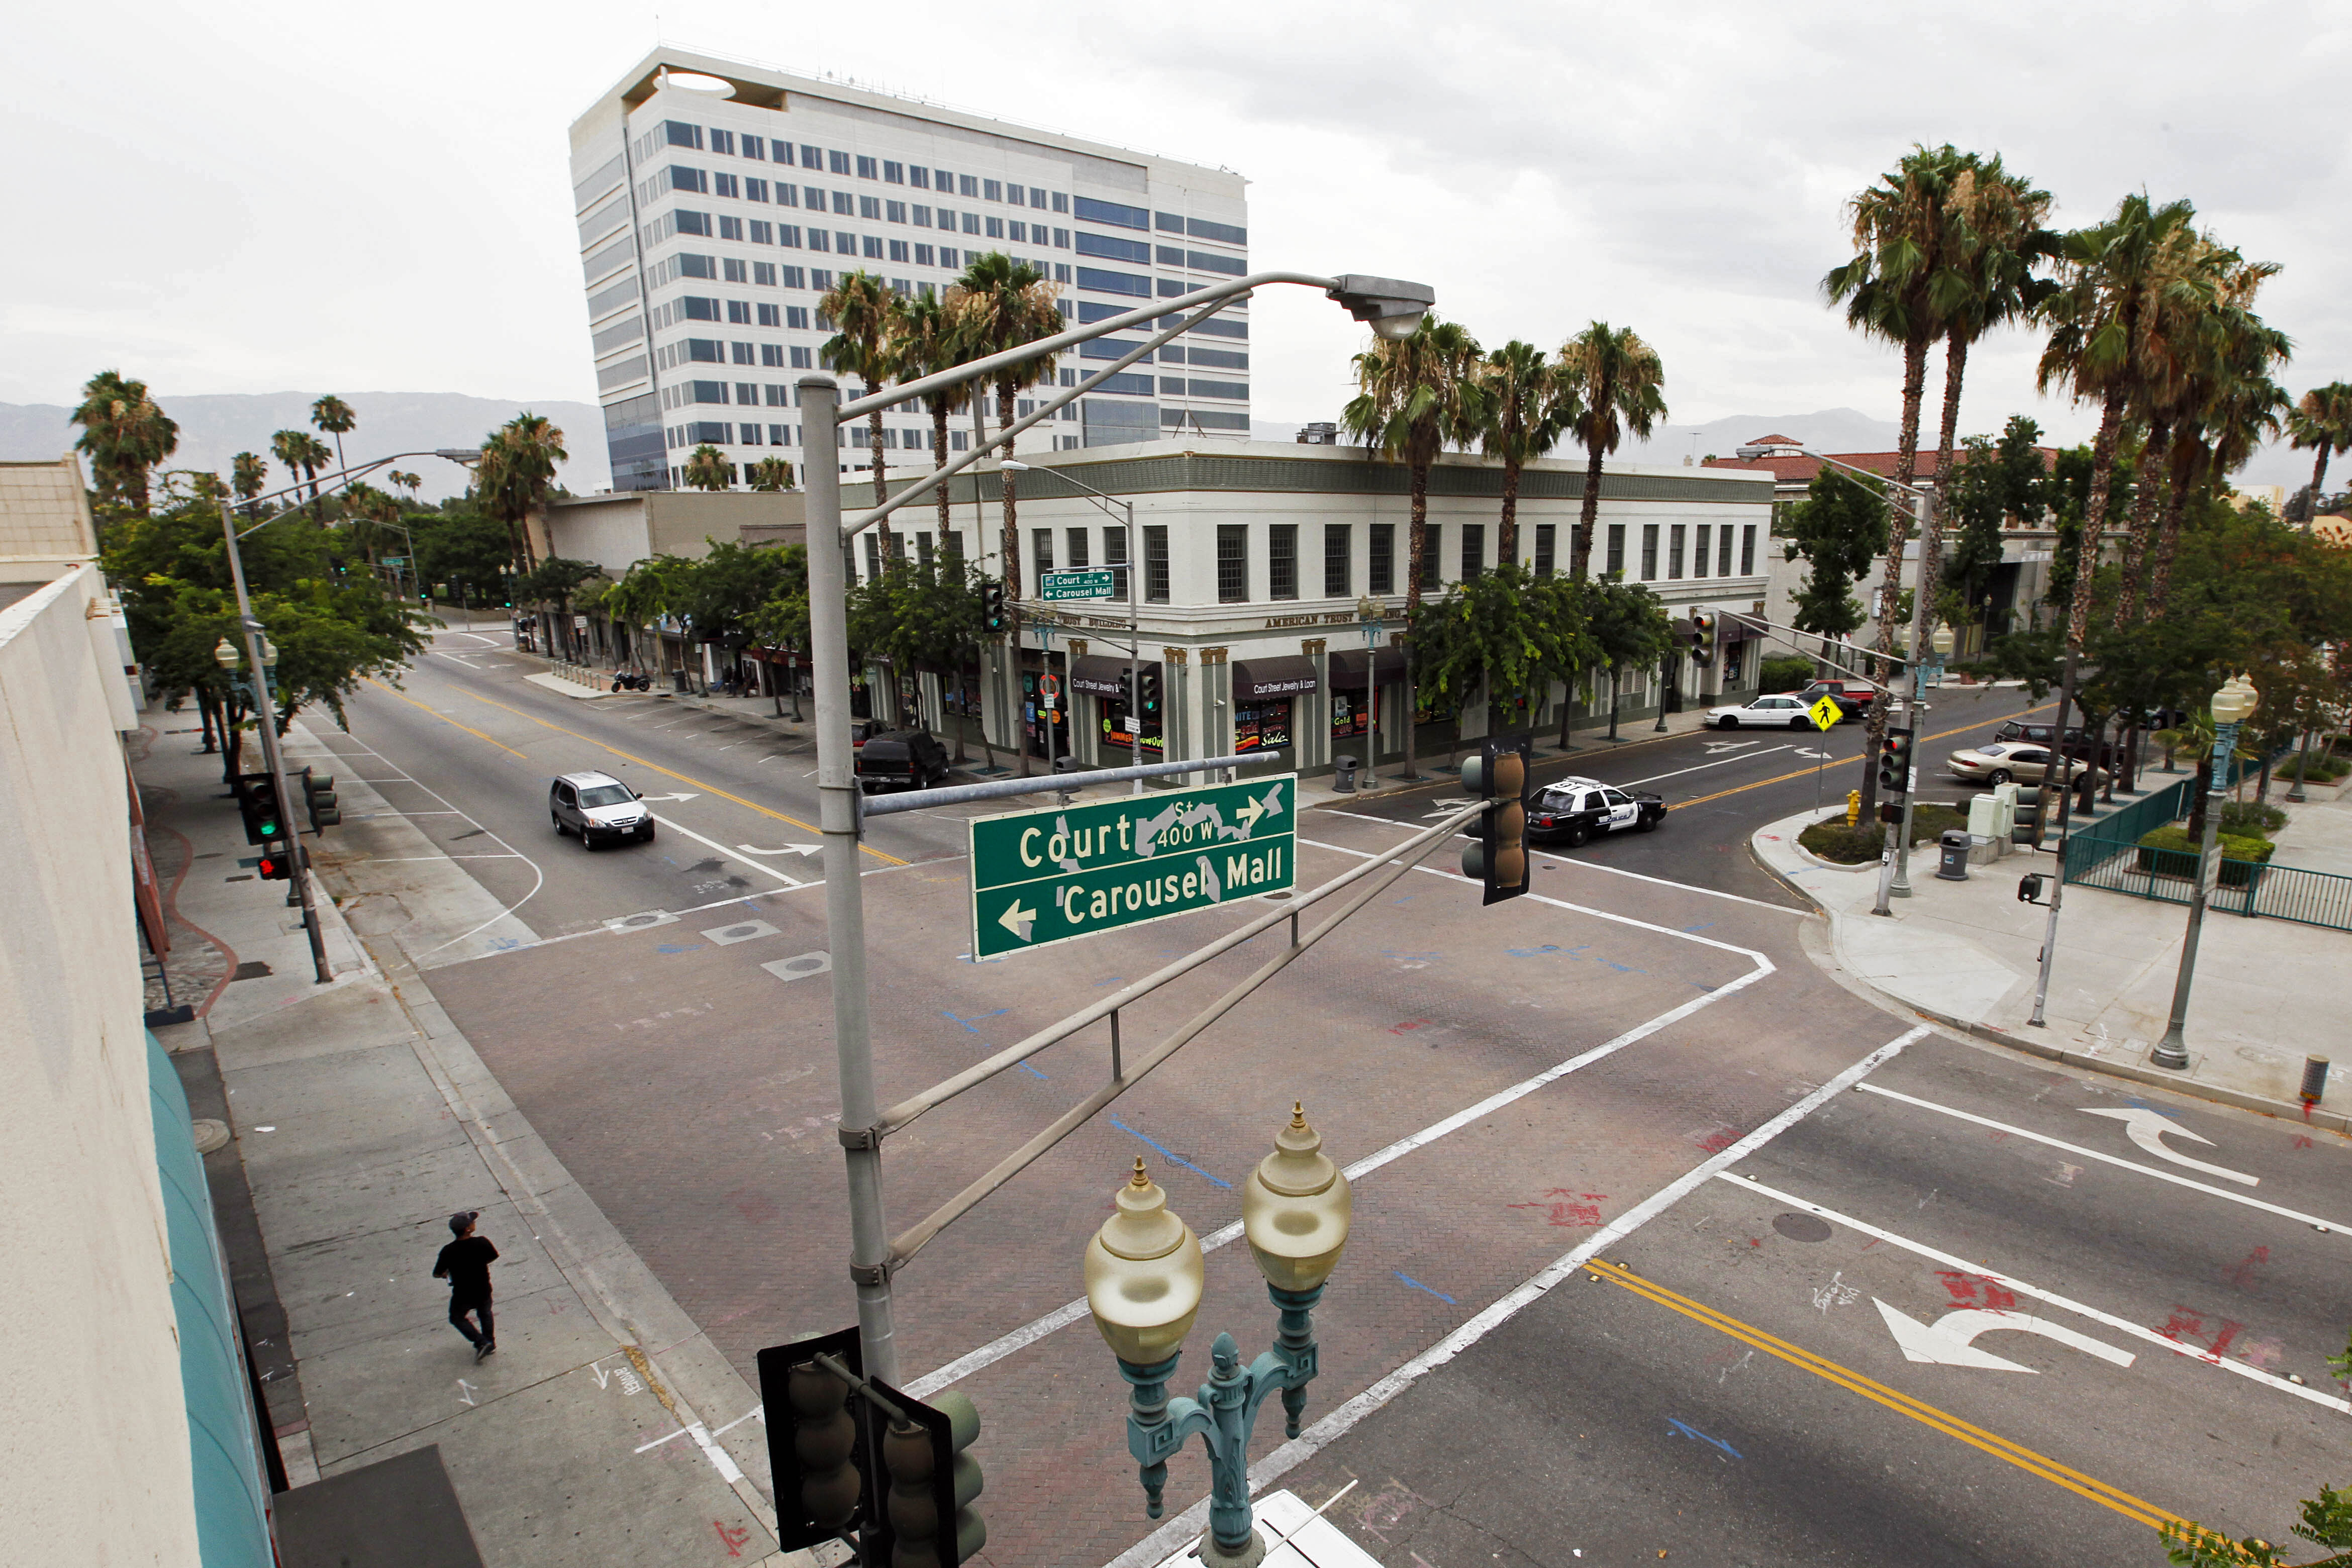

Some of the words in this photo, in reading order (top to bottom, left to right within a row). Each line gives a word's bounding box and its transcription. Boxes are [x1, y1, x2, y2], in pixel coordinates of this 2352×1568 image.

[1057, 576, 1080, 584] Court
[1056, 588, 1092, 598] Carousel
[1096, 587, 1111, 595] Mall
[1265, 615, 1319, 628] AMERICAN
[1324, 613, 1354, 624] TRUST
[1073, 678, 1085, 688] Court
[1086, 680, 1097, 690] Street
[1254, 684, 1267, 694] Court
[1268, 682, 1282, 693] Street
[1282, 681, 1299, 691] Jewelry
[1300, 680, 1304, 689] &
[1304, 680, 1316, 689] Loan
[1334, 716, 1350, 725] Gold
[1261, 732, 1288, 746] Sale
[1020, 813, 1131, 867] Court
[1175, 801, 1193, 820] St
[1157, 825, 1193, 847] 400
[1201, 822, 1213, 840] W
[1064, 862, 1206, 924] Carousel
[1227, 846, 1282, 890] Mall
